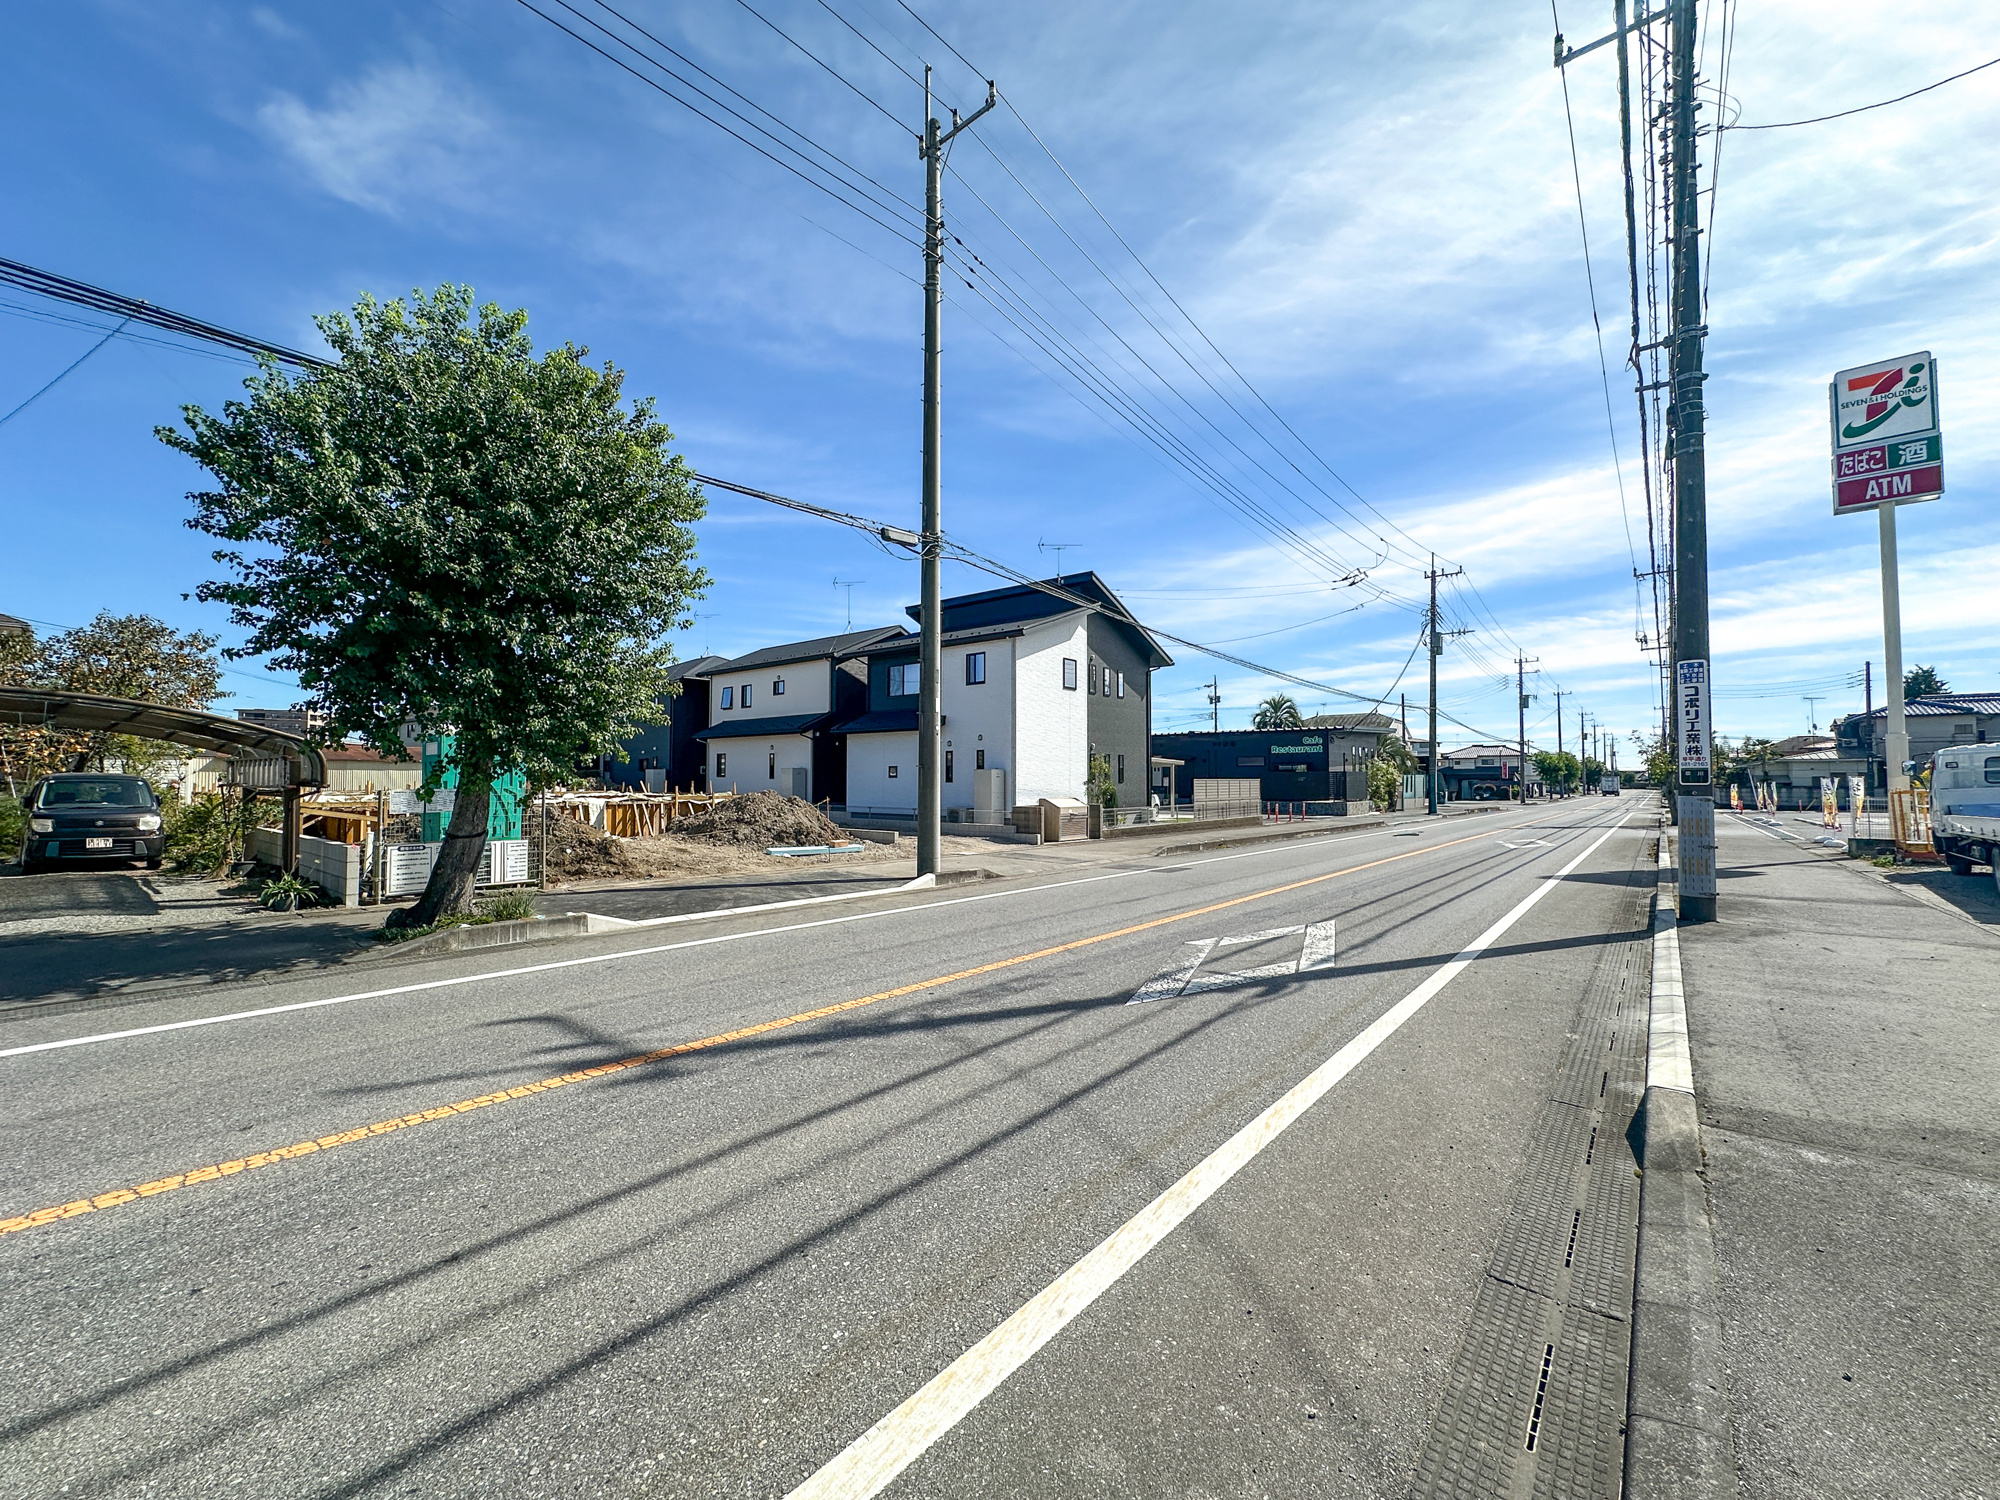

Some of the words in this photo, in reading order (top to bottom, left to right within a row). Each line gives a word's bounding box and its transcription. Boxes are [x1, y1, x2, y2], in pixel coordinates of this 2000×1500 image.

[1880, 385, 1928, 401] HOLDINGS
[1840, 450, 1884, 475] たばこ
[1898, 440, 1928, 465] 酒
[1865, 473, 1912, 500] ATM
[1271, 745, 1323, 754] Restaurant
[1302, 736, 1323, 744] Cafe
